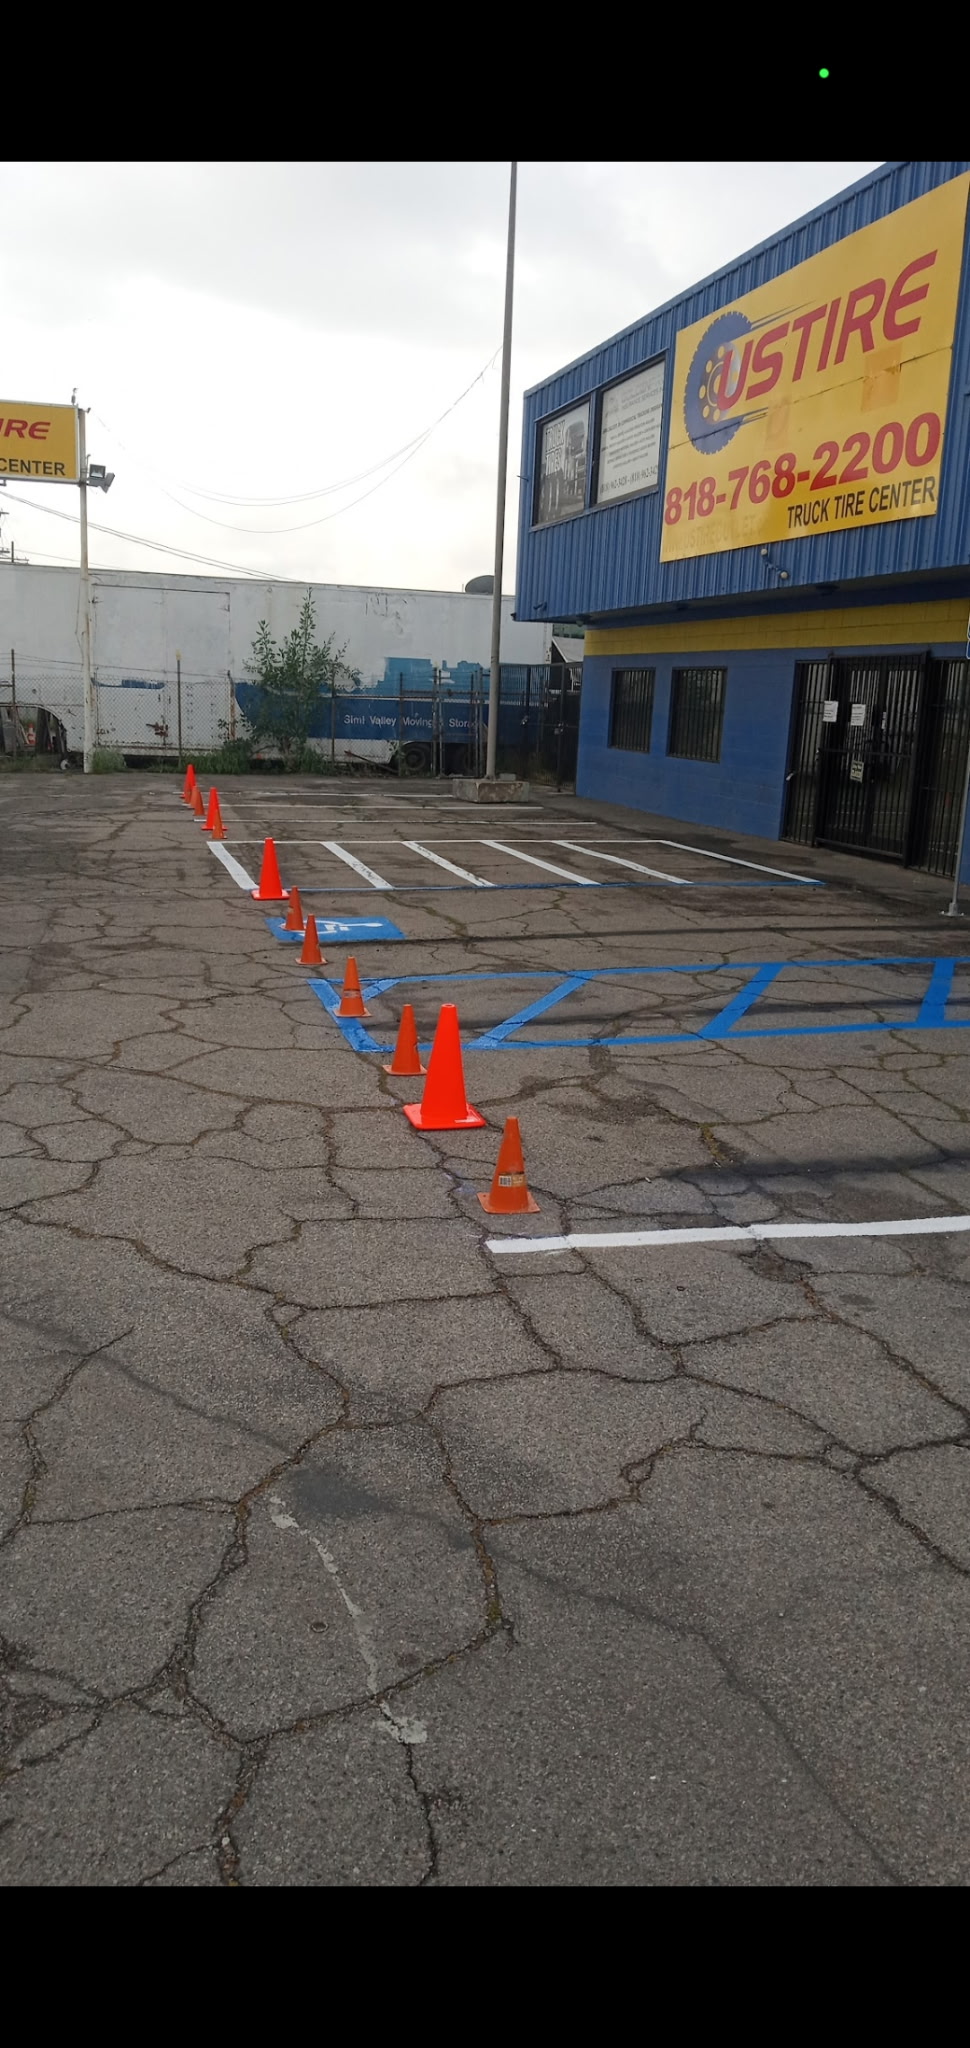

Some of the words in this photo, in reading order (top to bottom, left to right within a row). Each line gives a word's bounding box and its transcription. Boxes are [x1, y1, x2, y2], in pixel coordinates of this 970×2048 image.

[665, 412, 941, 525] 818-768-2200
[787, 500, 829, 529] TRUCK
[834, 490, 864, 520] TIRE
[868, 475, 936, 513] CENTER
[369, 715, 397, 727] Valley
[449, 718, 480, 728] Stora
